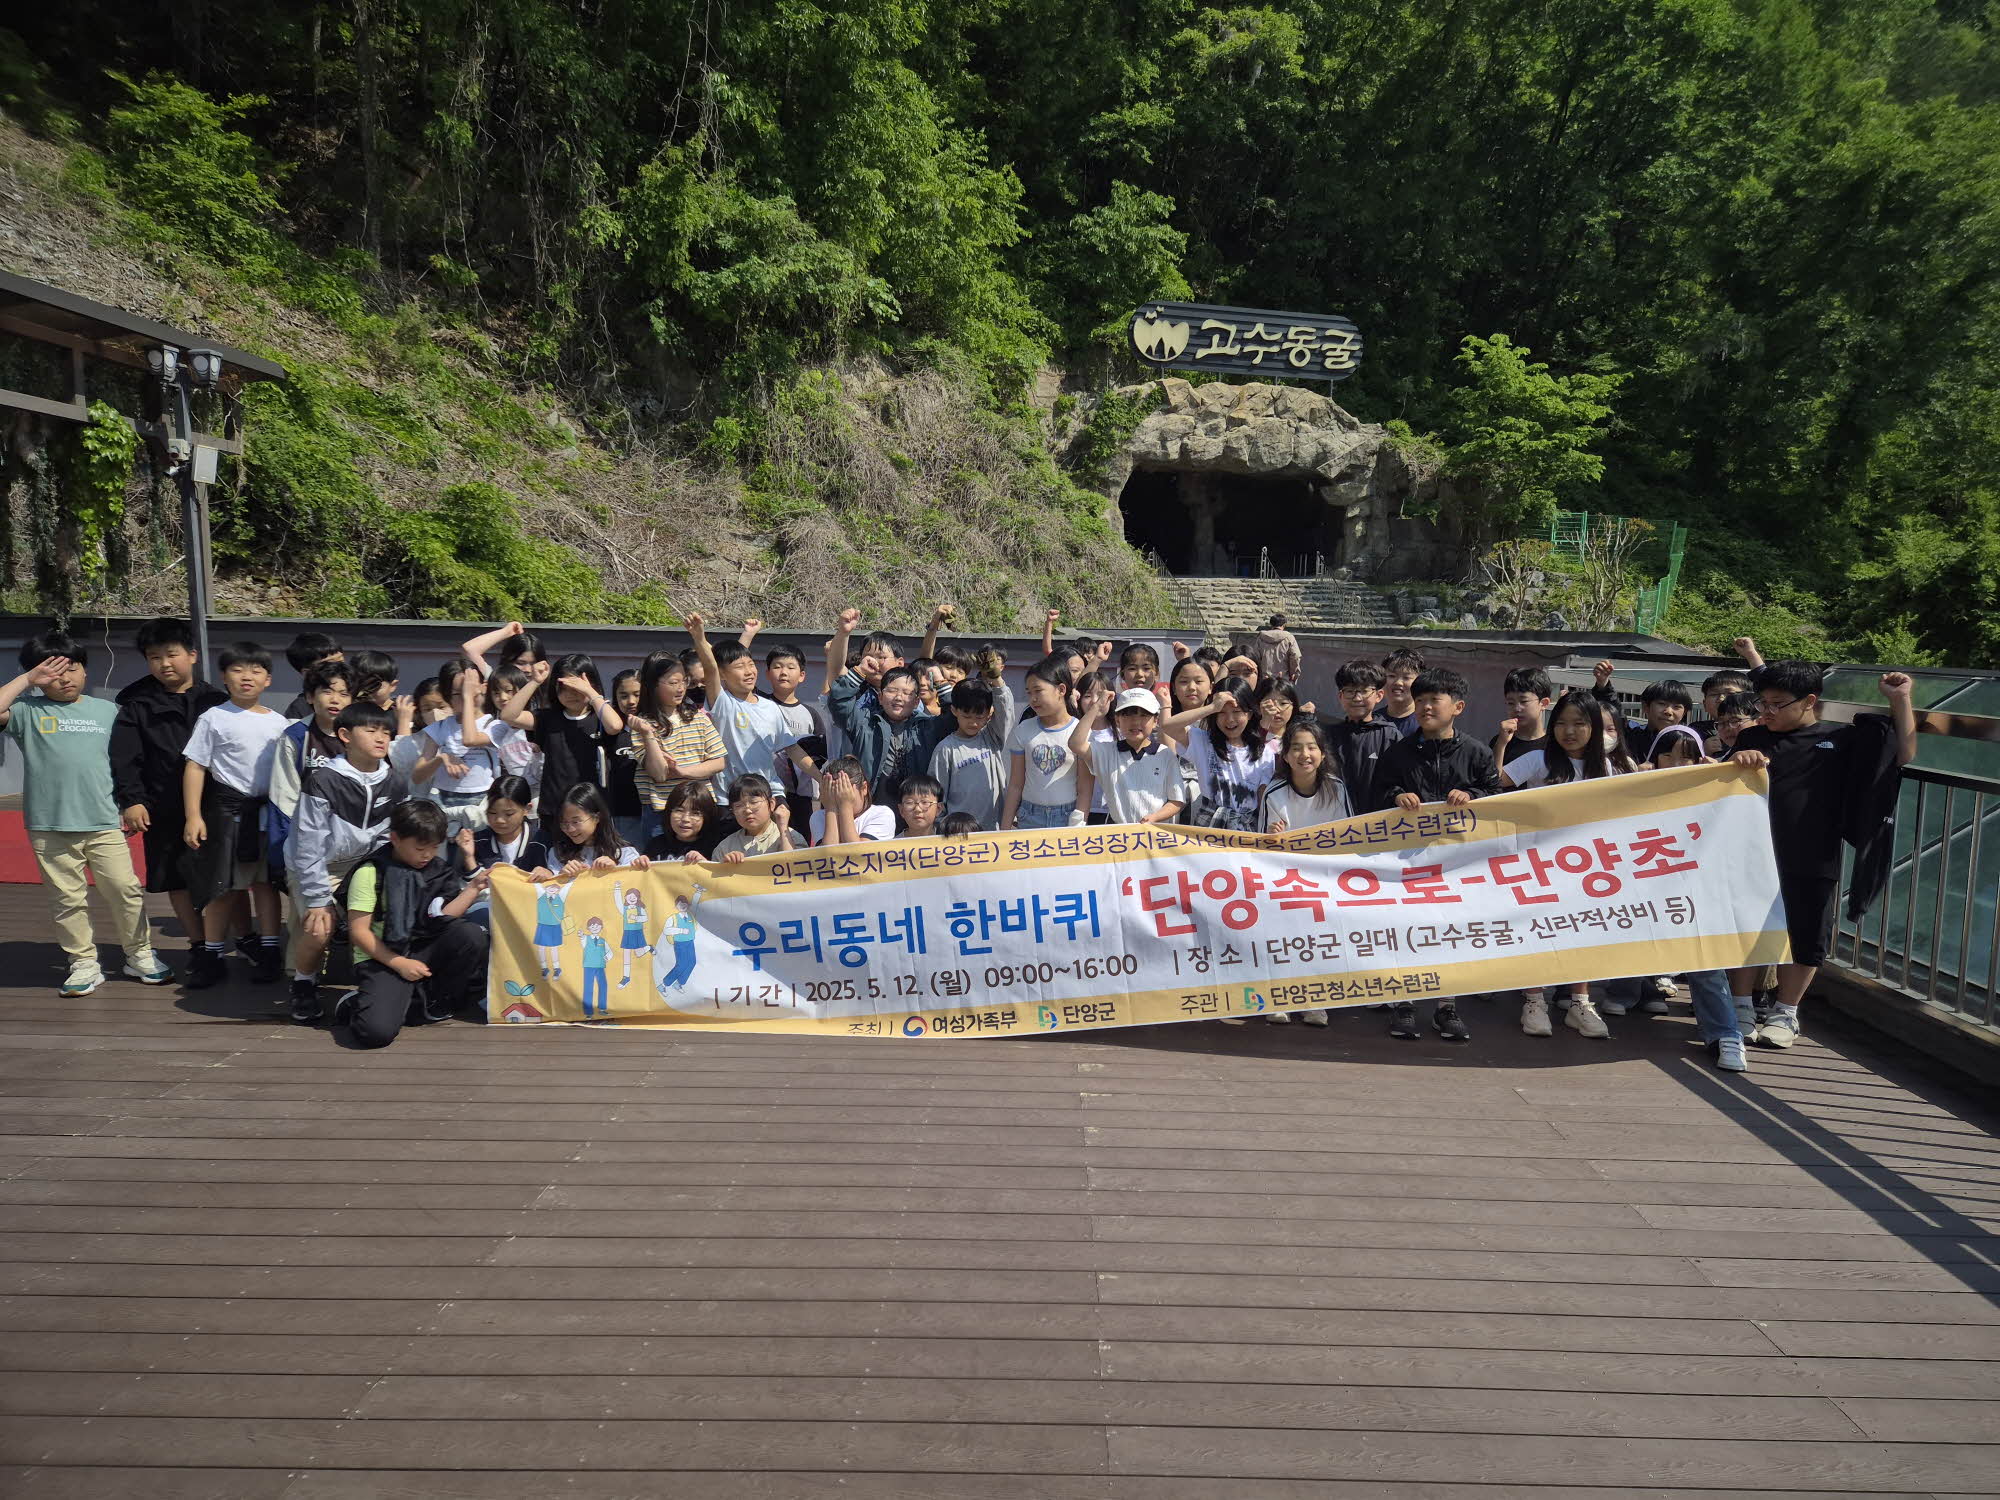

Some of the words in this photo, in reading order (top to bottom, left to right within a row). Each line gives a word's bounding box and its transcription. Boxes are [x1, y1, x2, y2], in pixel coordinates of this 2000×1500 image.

[1195, 319, 1361, 370] 고수동굴
[58, 718, 97, 727] NATIONAL
[58, 725, 107, 735] GEOGRAPHIC
[771, 841, 1000, 886] 인구감소지역(단양군)
[731, 905, 928, 971] 우리동네
[944, 889, 1101, 957] 한바퀴
[1266, 932, 1342, 965] 단양군
[1348, 927, 1399, 958] 일대
[1406, 919, 1524, 954] (고수동굴,
[1528, 900, 1659, 941] 신라적성비
[1664, 895, 1697, 927] 등)
[930, 968, 972, 997] (월)
[984, 953, 1138, 988] 09:00~16:00
[1180, 991, 1219, 1016] 주관
[1270, 971, 1441, 1007] 단양군청소년수련관
[932, 1009, 1018, 1035] 여성가족부
[1063, 1001, 1117, 1025] 단양군
